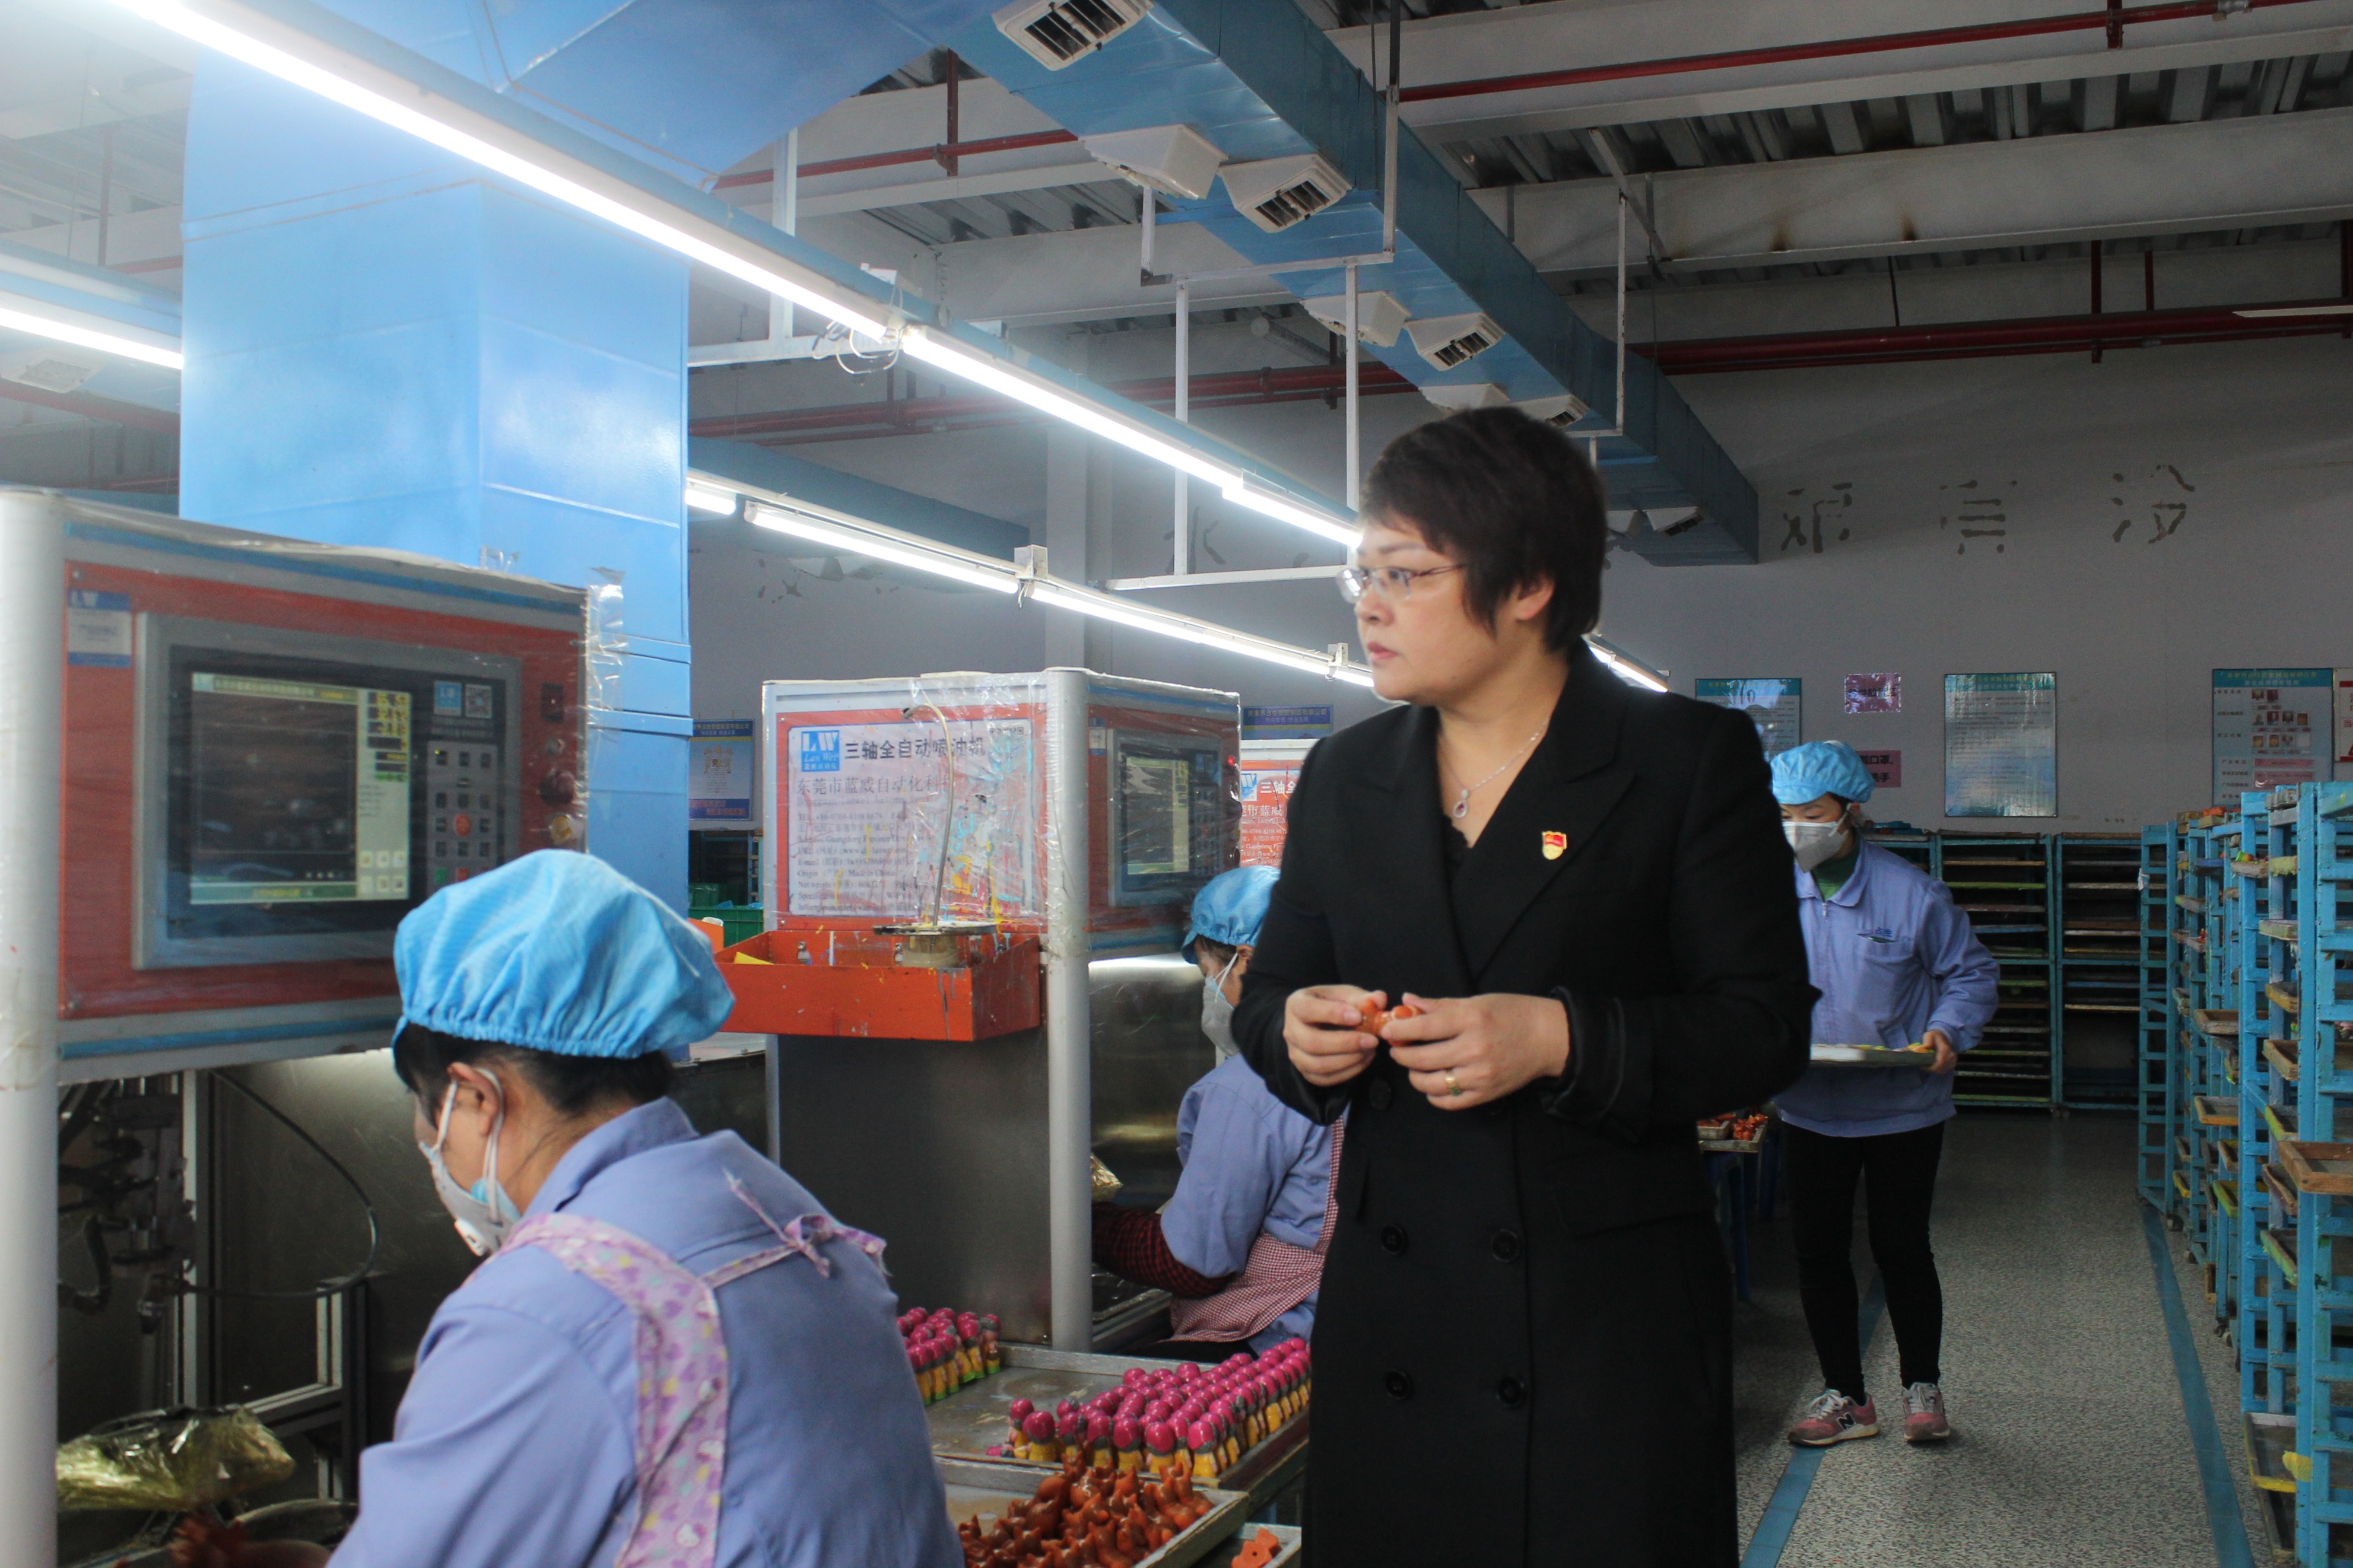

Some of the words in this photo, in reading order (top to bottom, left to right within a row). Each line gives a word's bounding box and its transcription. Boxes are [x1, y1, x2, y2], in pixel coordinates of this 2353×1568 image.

[802, 732, 838, 751] LW
[1241, 805, 1287, 816] 莞市蓝威
[1837, 1413, 1855, 1430] N
